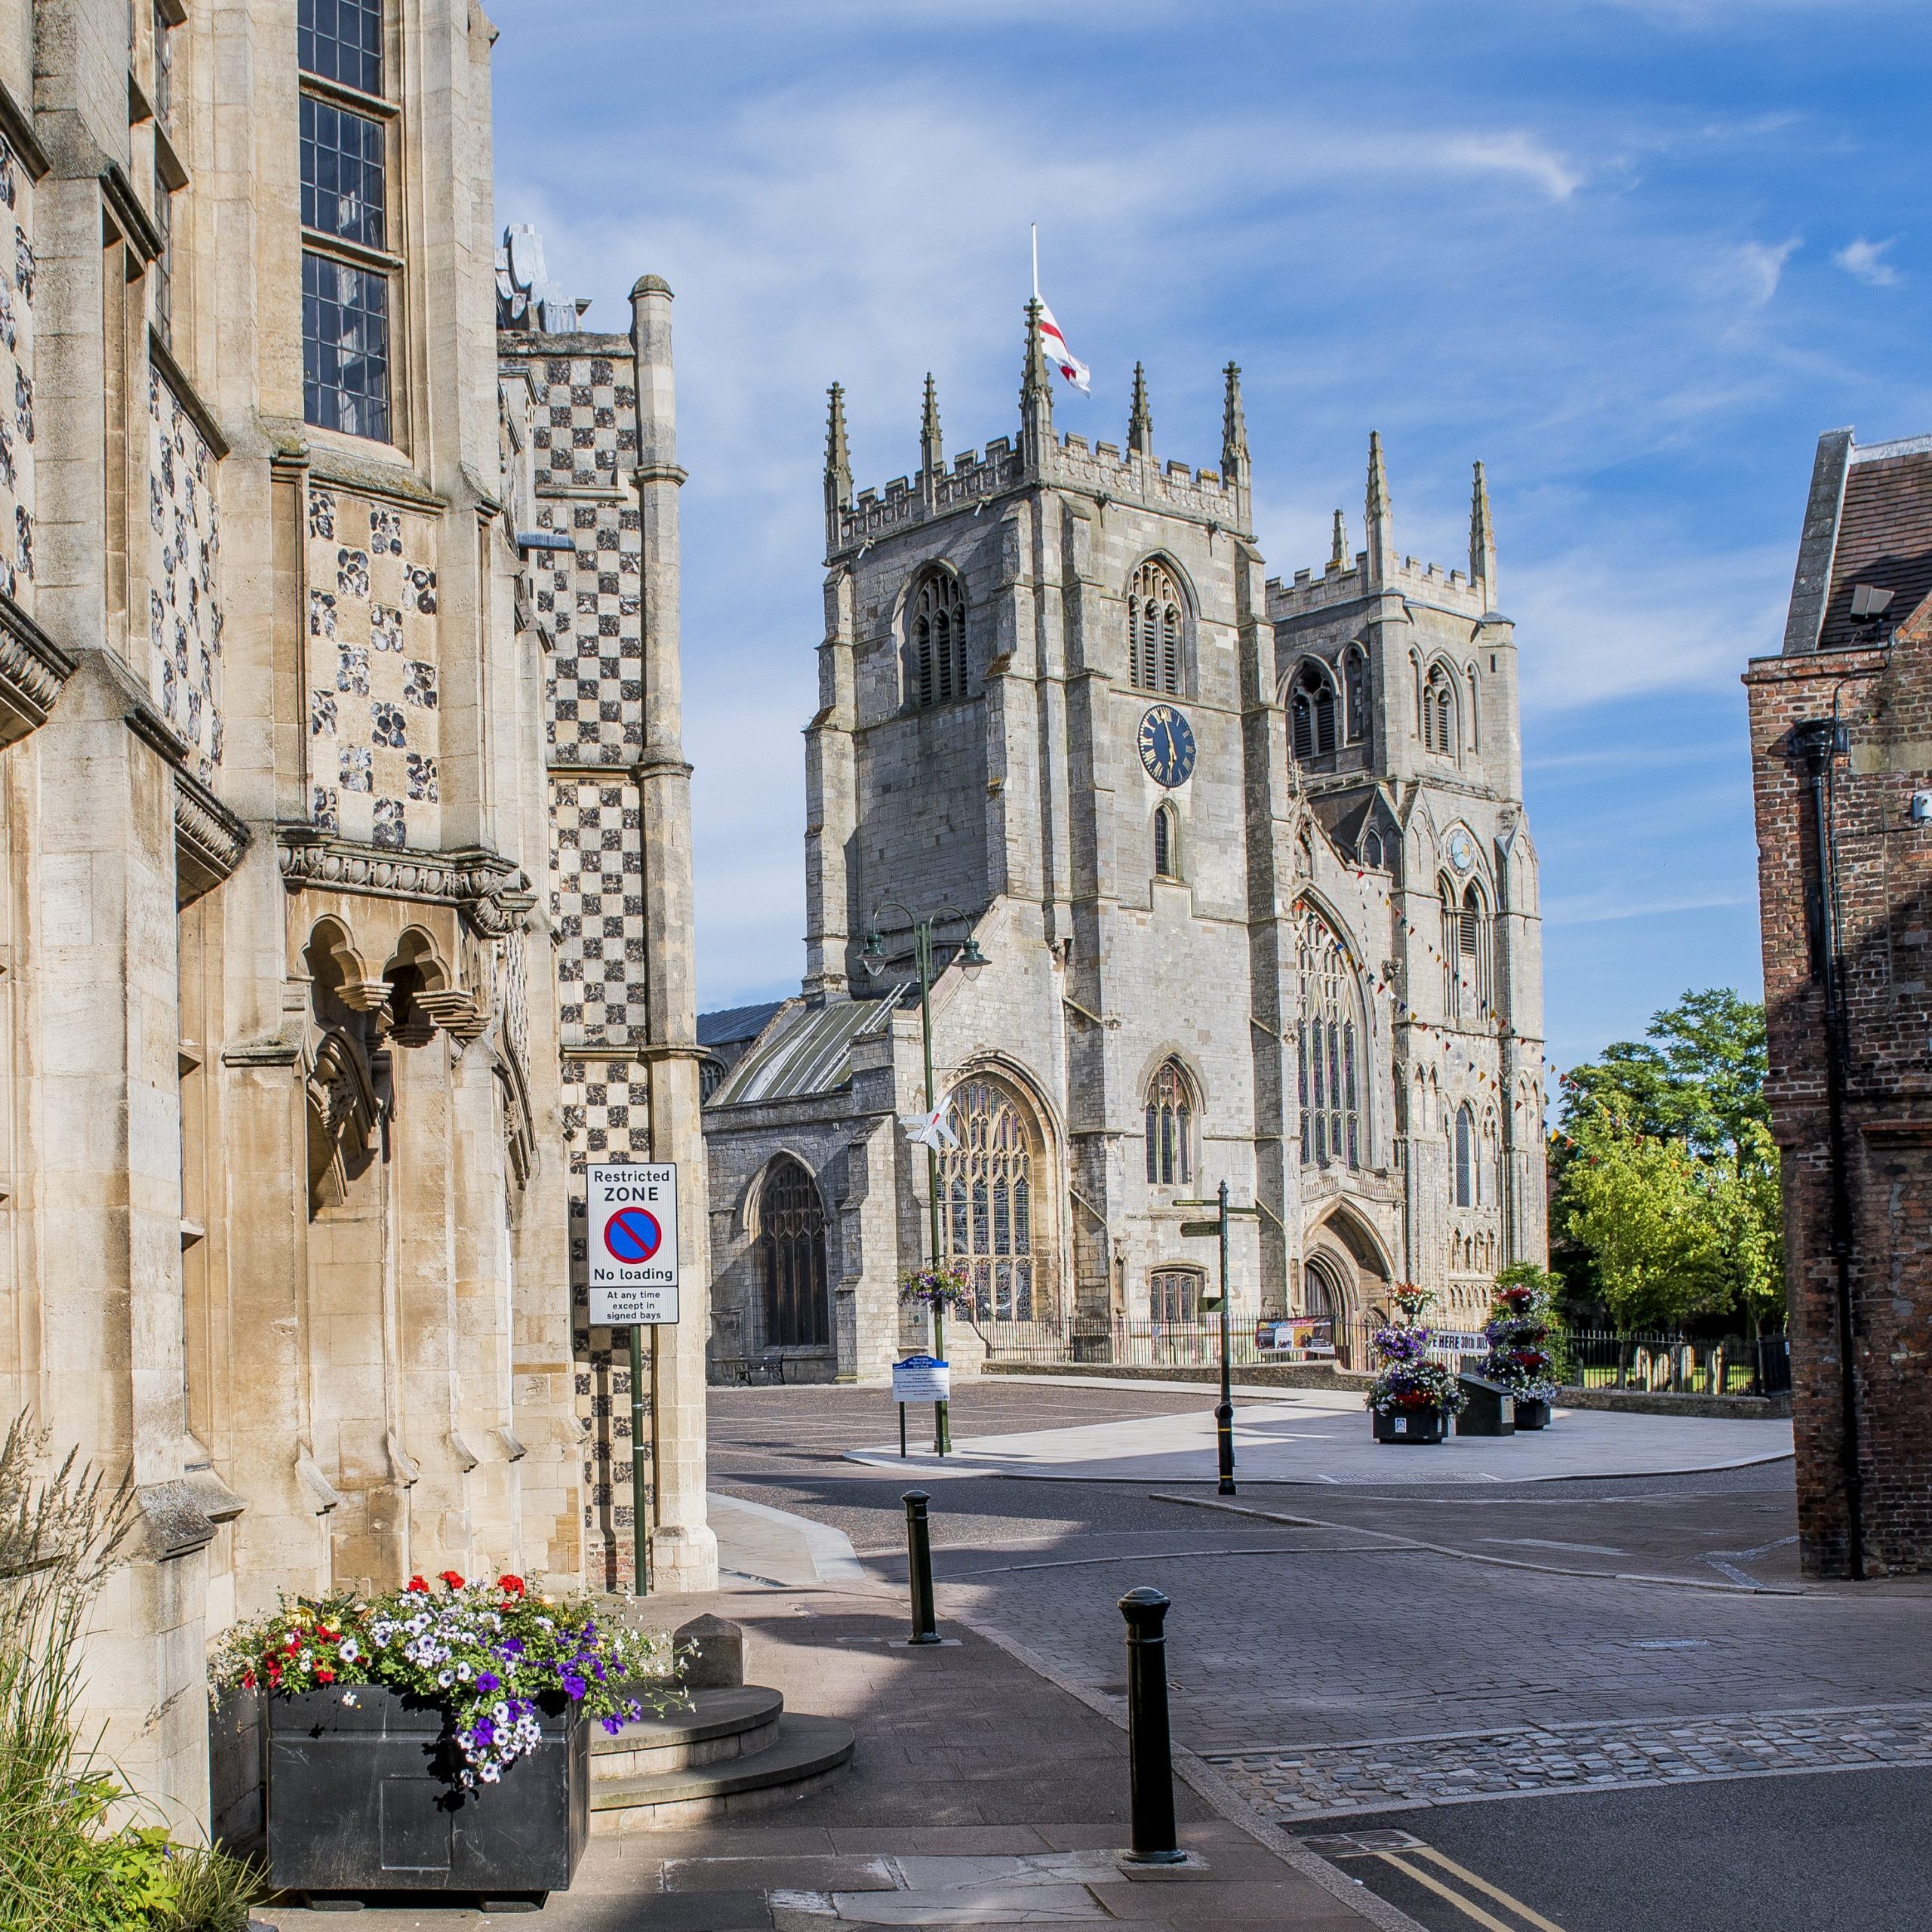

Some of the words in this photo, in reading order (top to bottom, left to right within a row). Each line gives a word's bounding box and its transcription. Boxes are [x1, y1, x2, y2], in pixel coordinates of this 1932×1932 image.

[594, 1170, 669, 1182] Restricted
[604, 1186, 659, 1201] ZONE
[594, 1268, 614, 1280] No
[620, 1268, 672, 1281] loading
[612, 1302, 644, 1310] except
[607, 1312, 637, 1321] signed
[640, 1312, 661, 1320] bays
[1438, 1335, 1460, 1349] HERE
[1460, 1336, 1475, 1349] 30th
